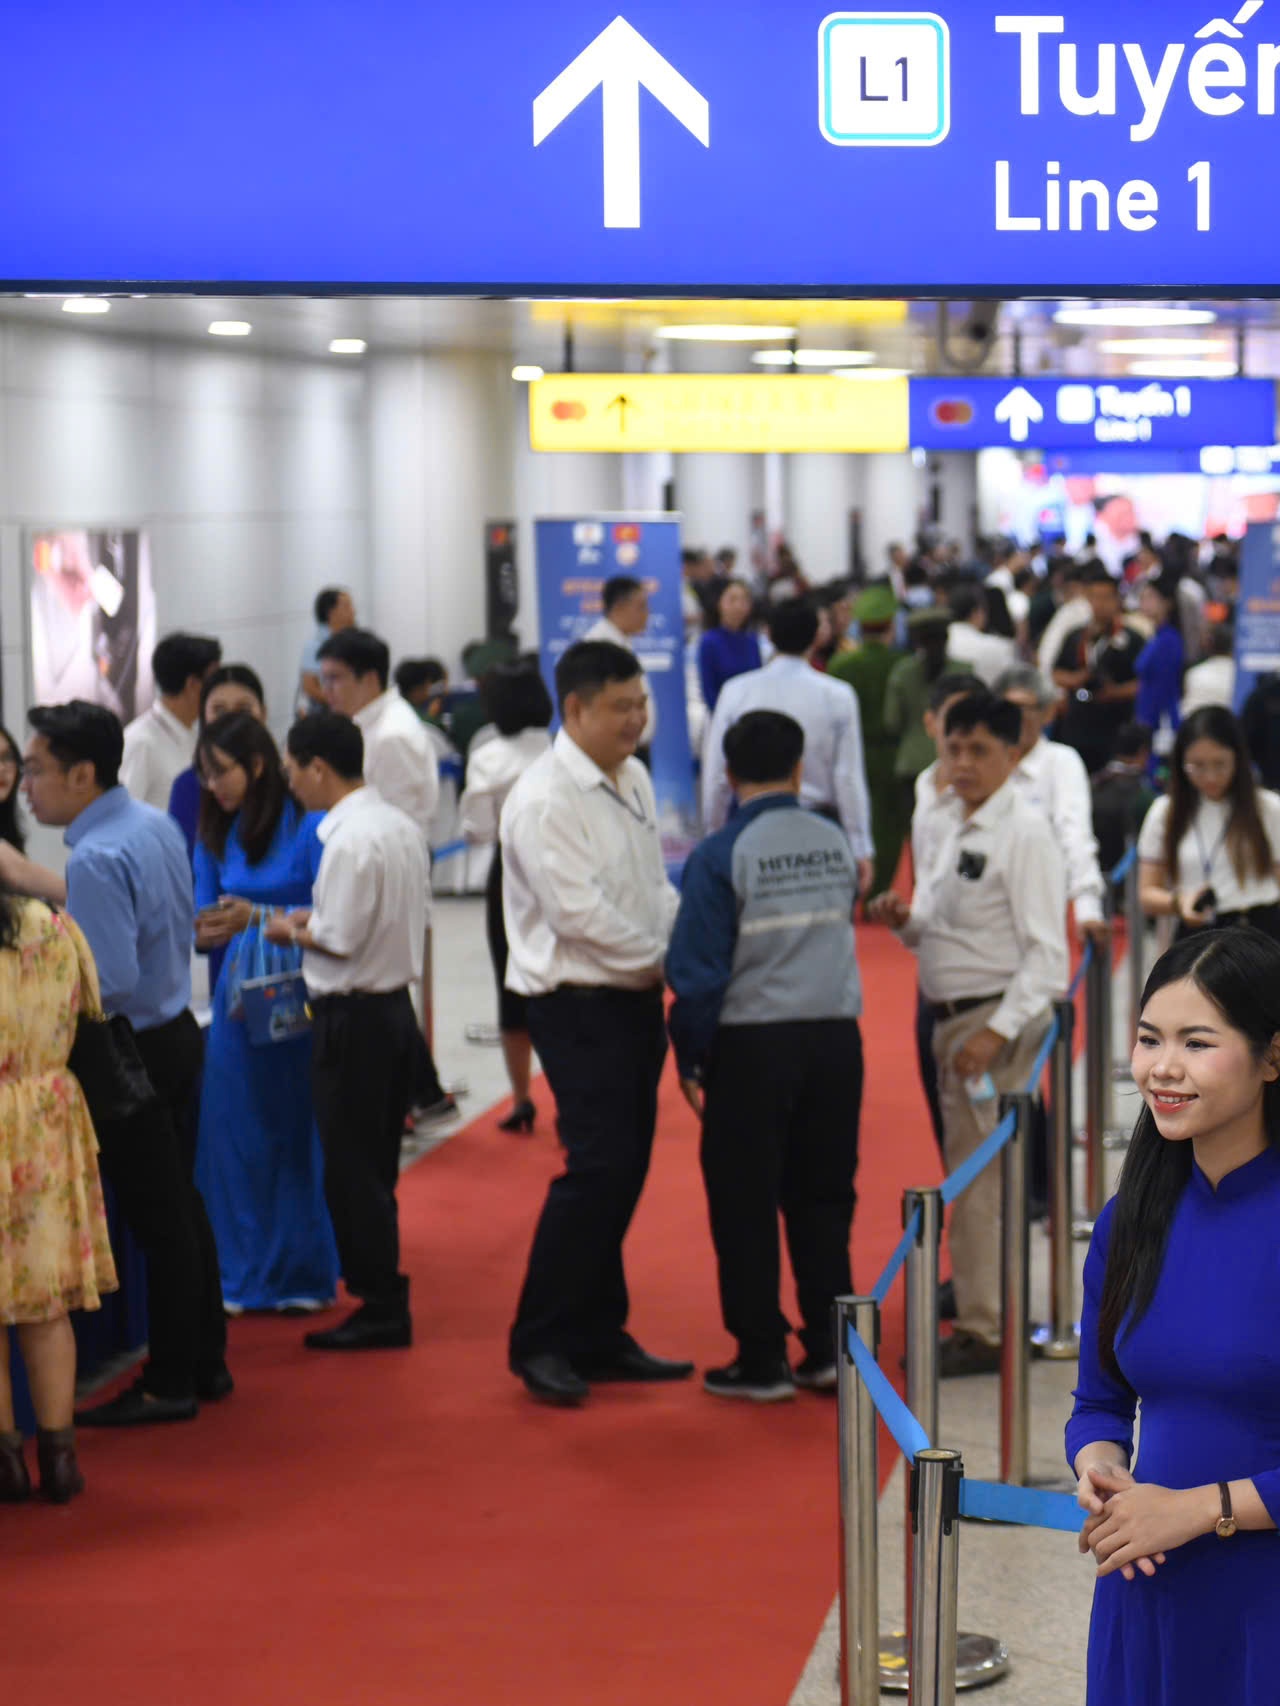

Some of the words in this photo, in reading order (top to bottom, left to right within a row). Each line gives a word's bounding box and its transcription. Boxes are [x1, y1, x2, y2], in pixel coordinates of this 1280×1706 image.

[860, 56, 908, 102] L1
[994, 159, 1160, 233] Line
[1186, 160, 1211, 232] 1
